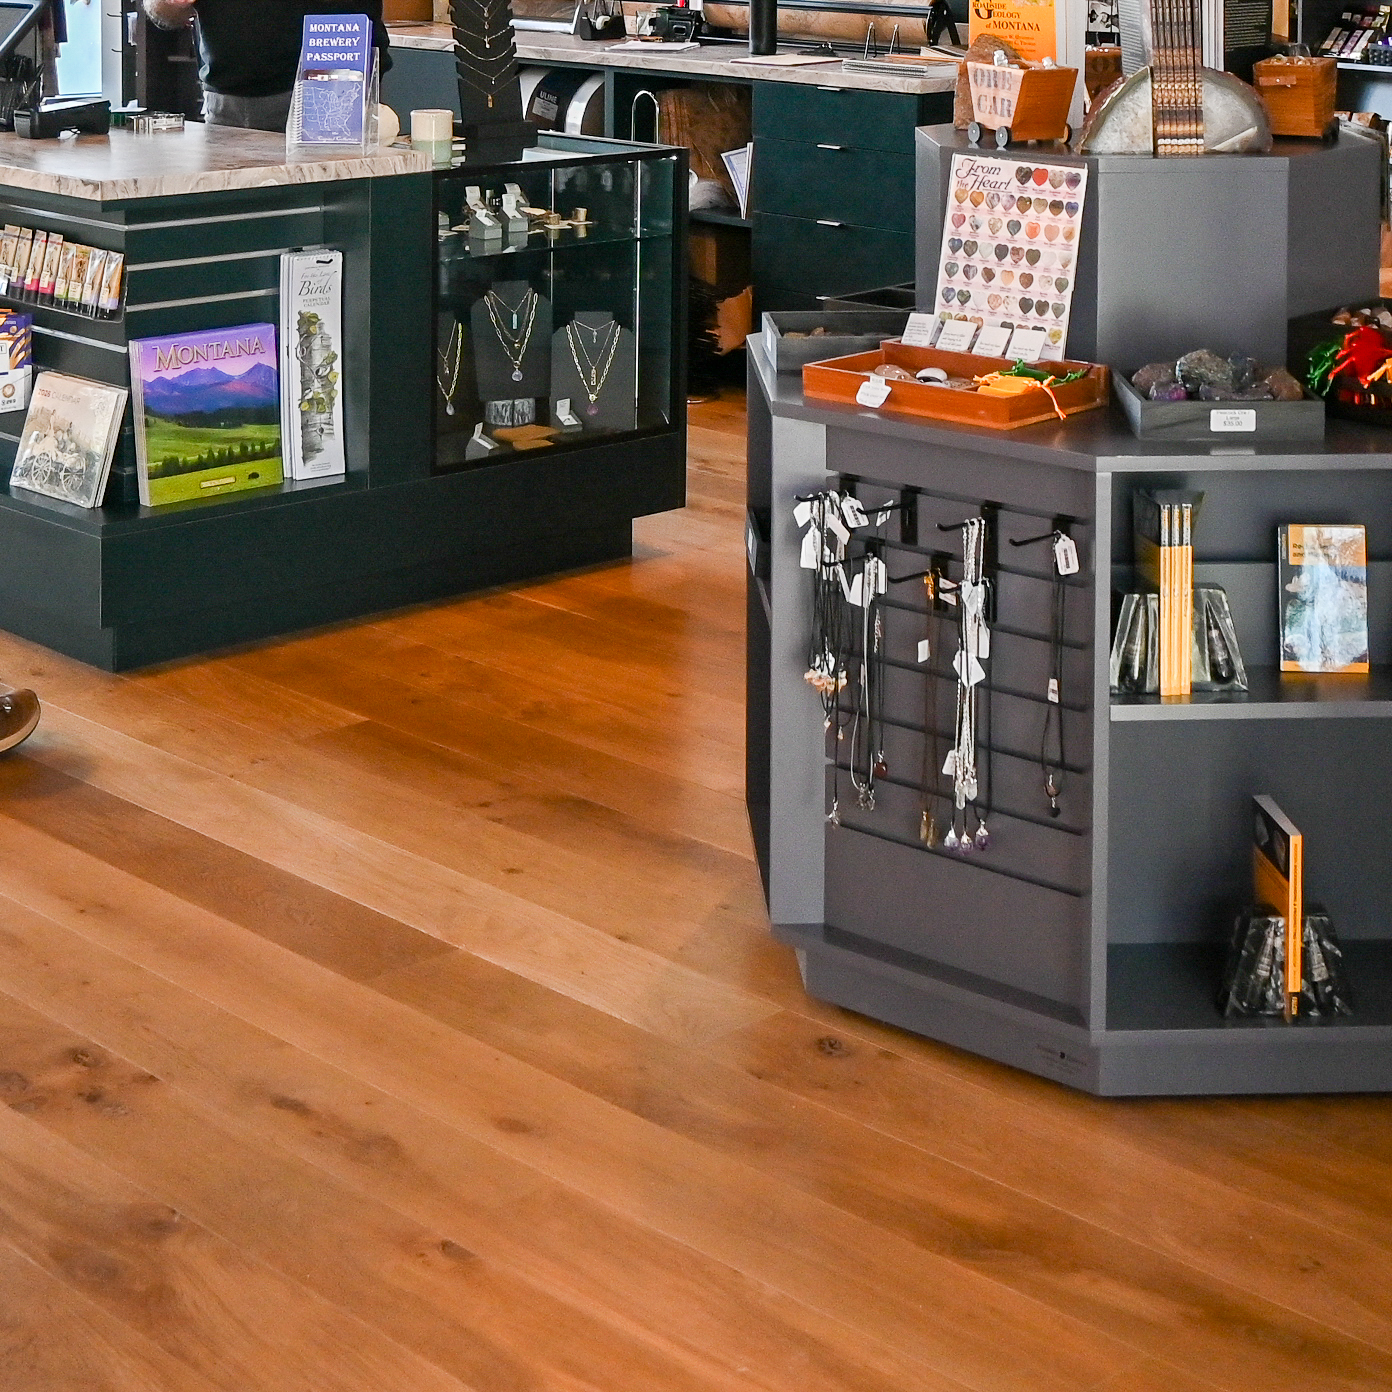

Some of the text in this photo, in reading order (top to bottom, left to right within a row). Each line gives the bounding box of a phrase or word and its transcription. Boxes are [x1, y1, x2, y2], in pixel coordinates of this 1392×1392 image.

[972, 2, 1006, 10] ROADSIDE
[309, 23, 360, 33] MONTANA
[993, 21, 1040, 32] MONTANA
[308, 37, 361, 47] BREWERY
[306, 52, 361, 62] PASSPORT
[973, 67, 1012, 91] ORE
[539, 90, 558, 104] ULINE
[977, 94, 1012, 118] CAR
[955, 158, 1002, 180] From
[968, 173, 1013, 192] Heart
[298, 270, 337, 297] Birds
[152, 336, 266, 373] MONTANA
[51, 391, 81, 405] CALENDAR
